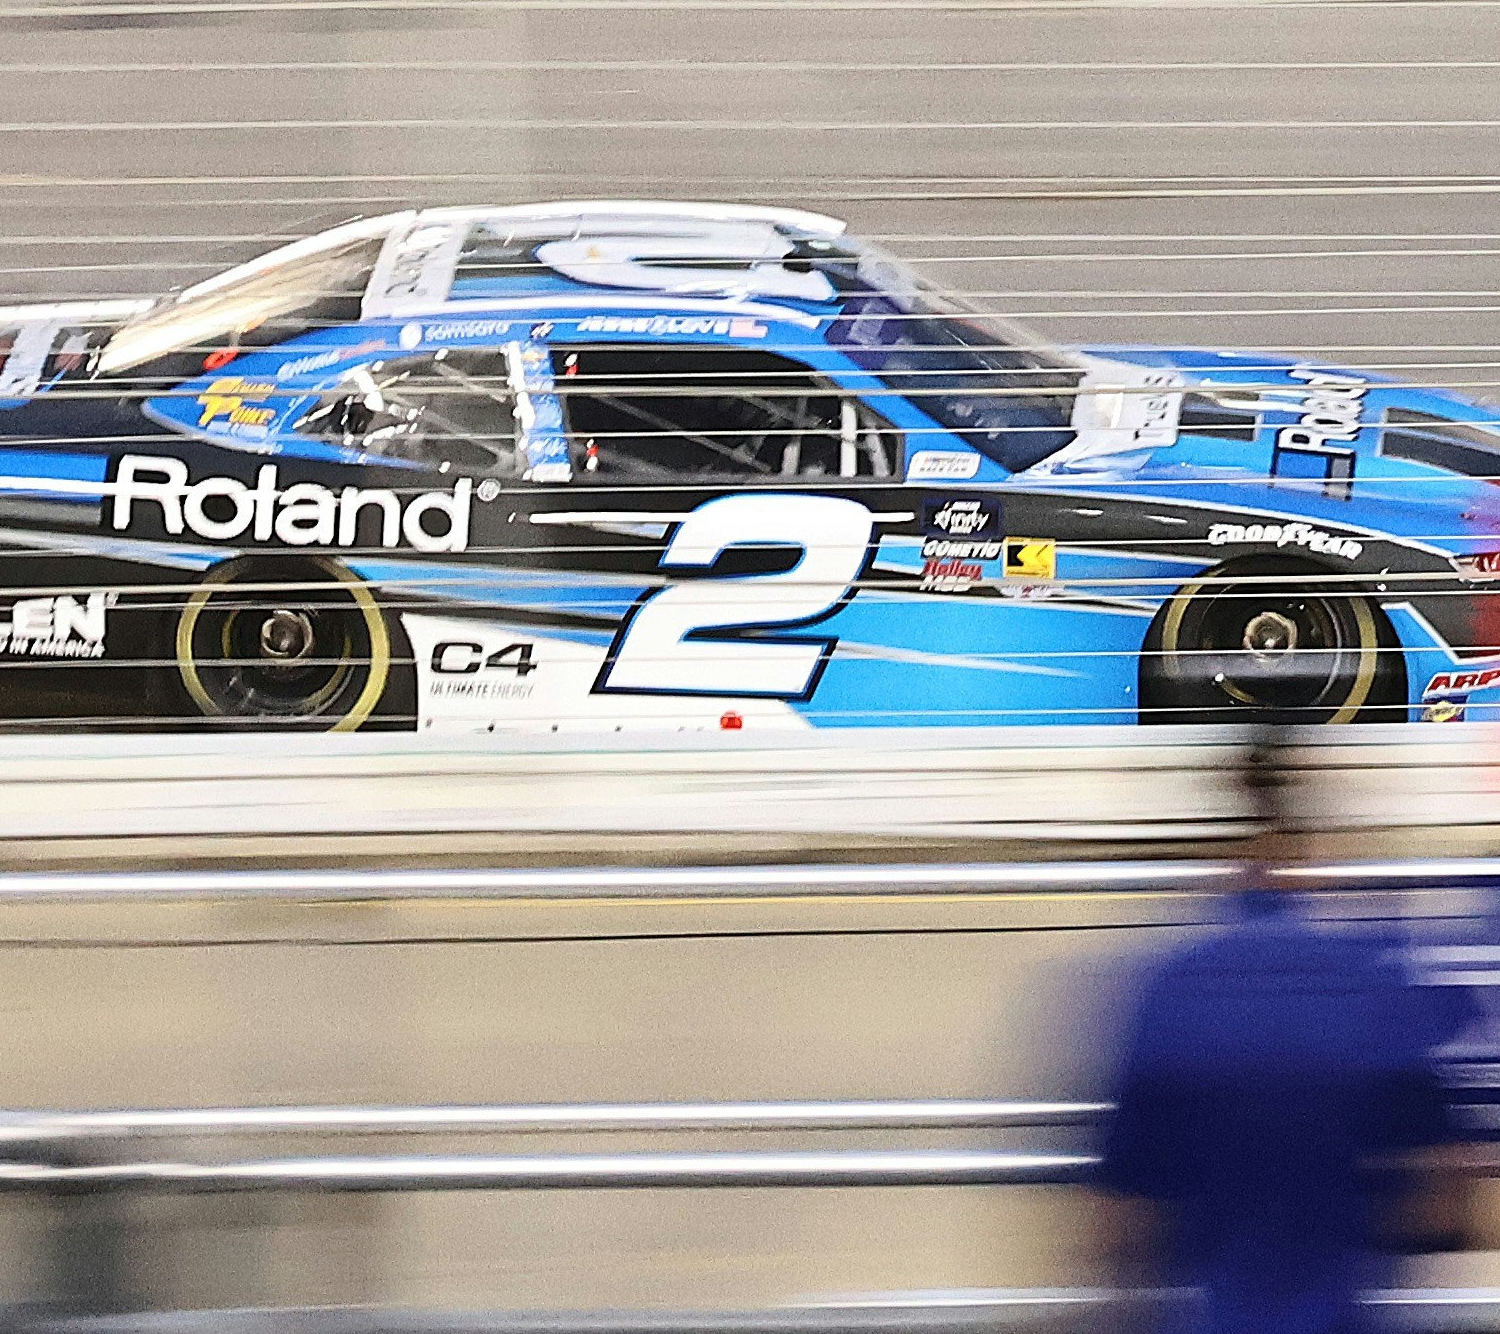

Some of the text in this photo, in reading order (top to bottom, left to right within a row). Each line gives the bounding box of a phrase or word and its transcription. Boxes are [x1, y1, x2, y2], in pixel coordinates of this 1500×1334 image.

[113, 455, 472, 552] Roland
[1208, 523, 1363, 560] GOODYEAR
[589, 490, 877, 702] 2
[431, 642, 538, 677] C4
